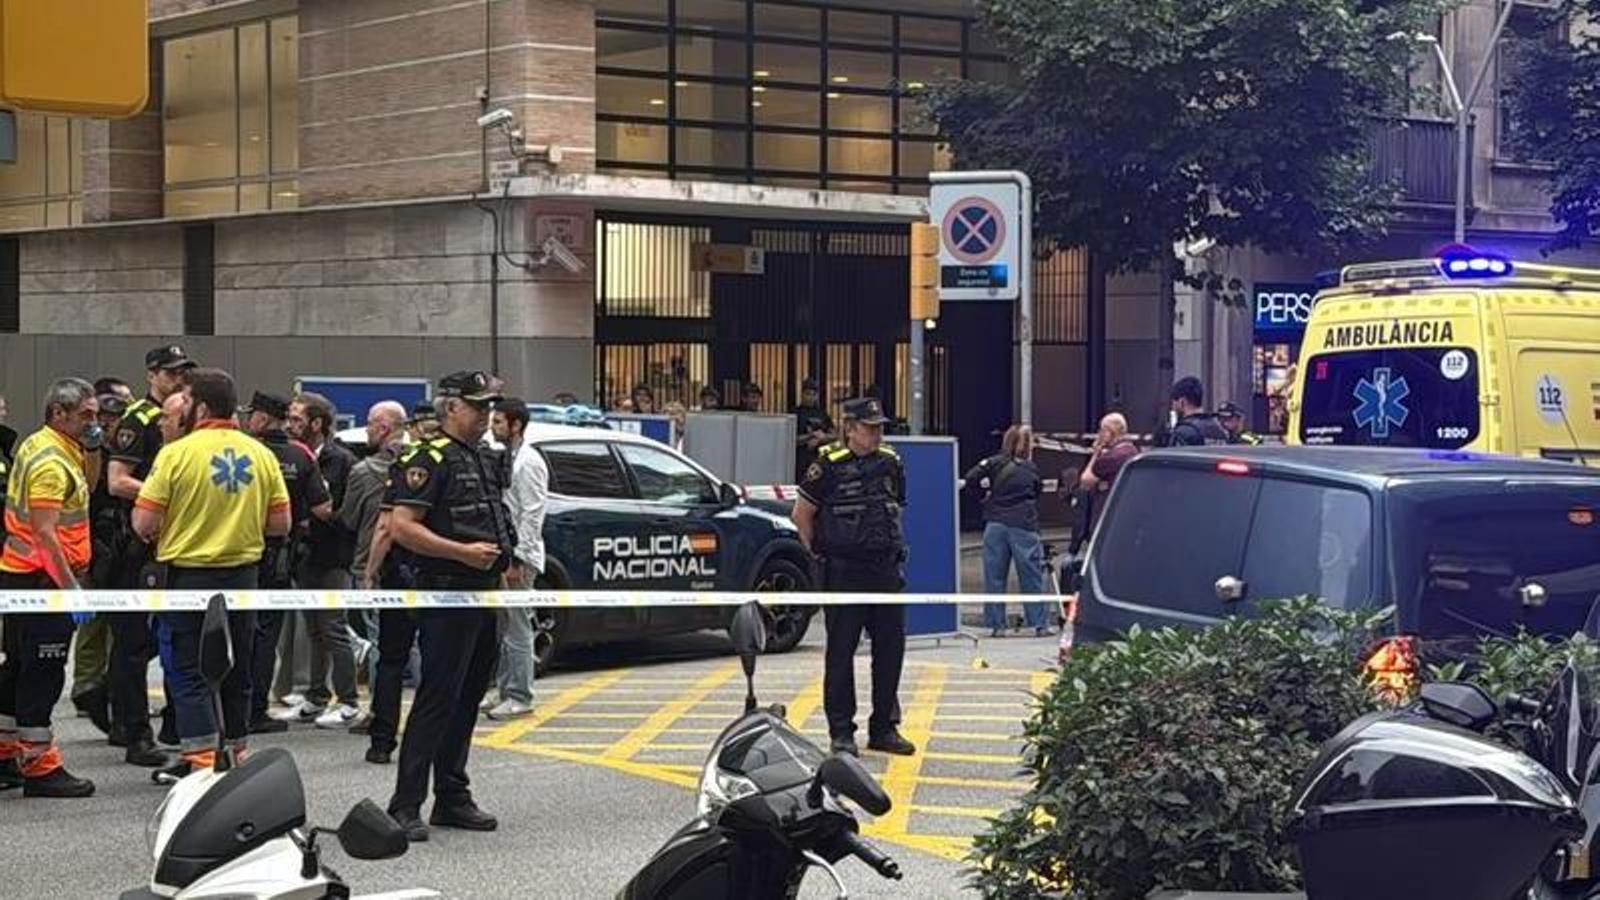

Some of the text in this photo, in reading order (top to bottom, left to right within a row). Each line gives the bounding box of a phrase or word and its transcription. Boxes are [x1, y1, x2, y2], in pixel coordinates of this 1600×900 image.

[1323, 318, 1454, 349] AMBULÀNCIA
[1446, 356, 1464, 366] 112
[1539, 387, 1562, 406] 112
[1436, 427, 1469, 439] 1200
[593, 534, 694, 558] POLICIA
[593, 556, 716, 580] NACIONAL
